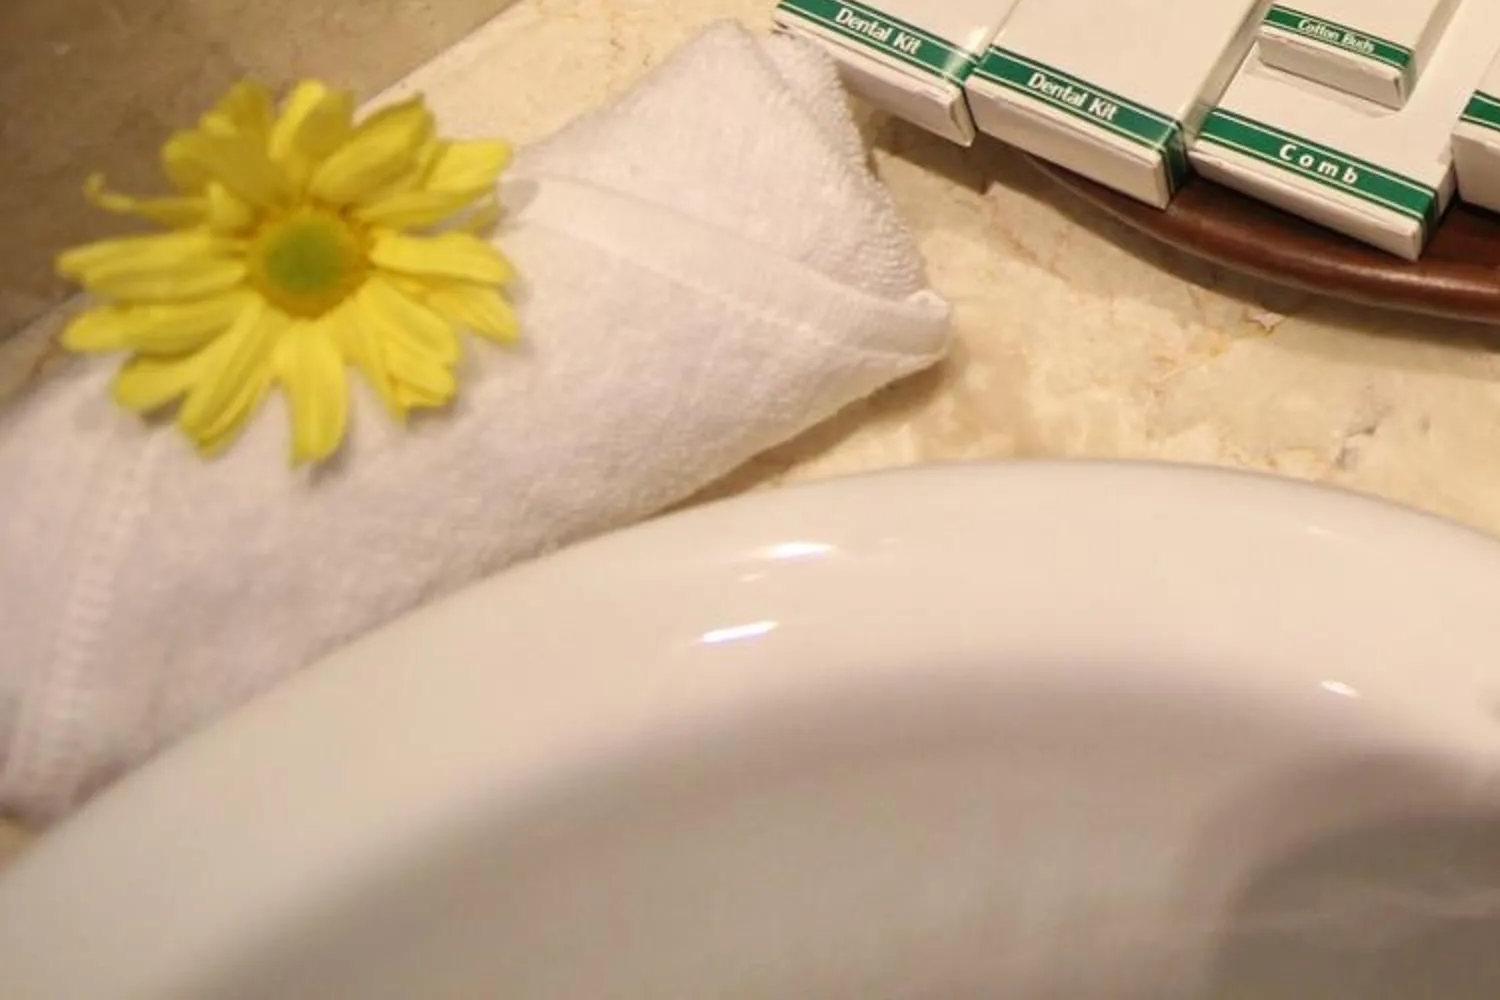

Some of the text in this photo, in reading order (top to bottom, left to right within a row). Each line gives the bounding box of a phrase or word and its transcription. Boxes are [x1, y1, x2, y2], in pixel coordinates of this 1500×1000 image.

[835, 7, 922, 55] Dental Kit
[1298, 18, 1341, 41] Cotton
[1027, 72, 1119, 121] Dental Kit
[1279, 143, 1358, 184] Comb
